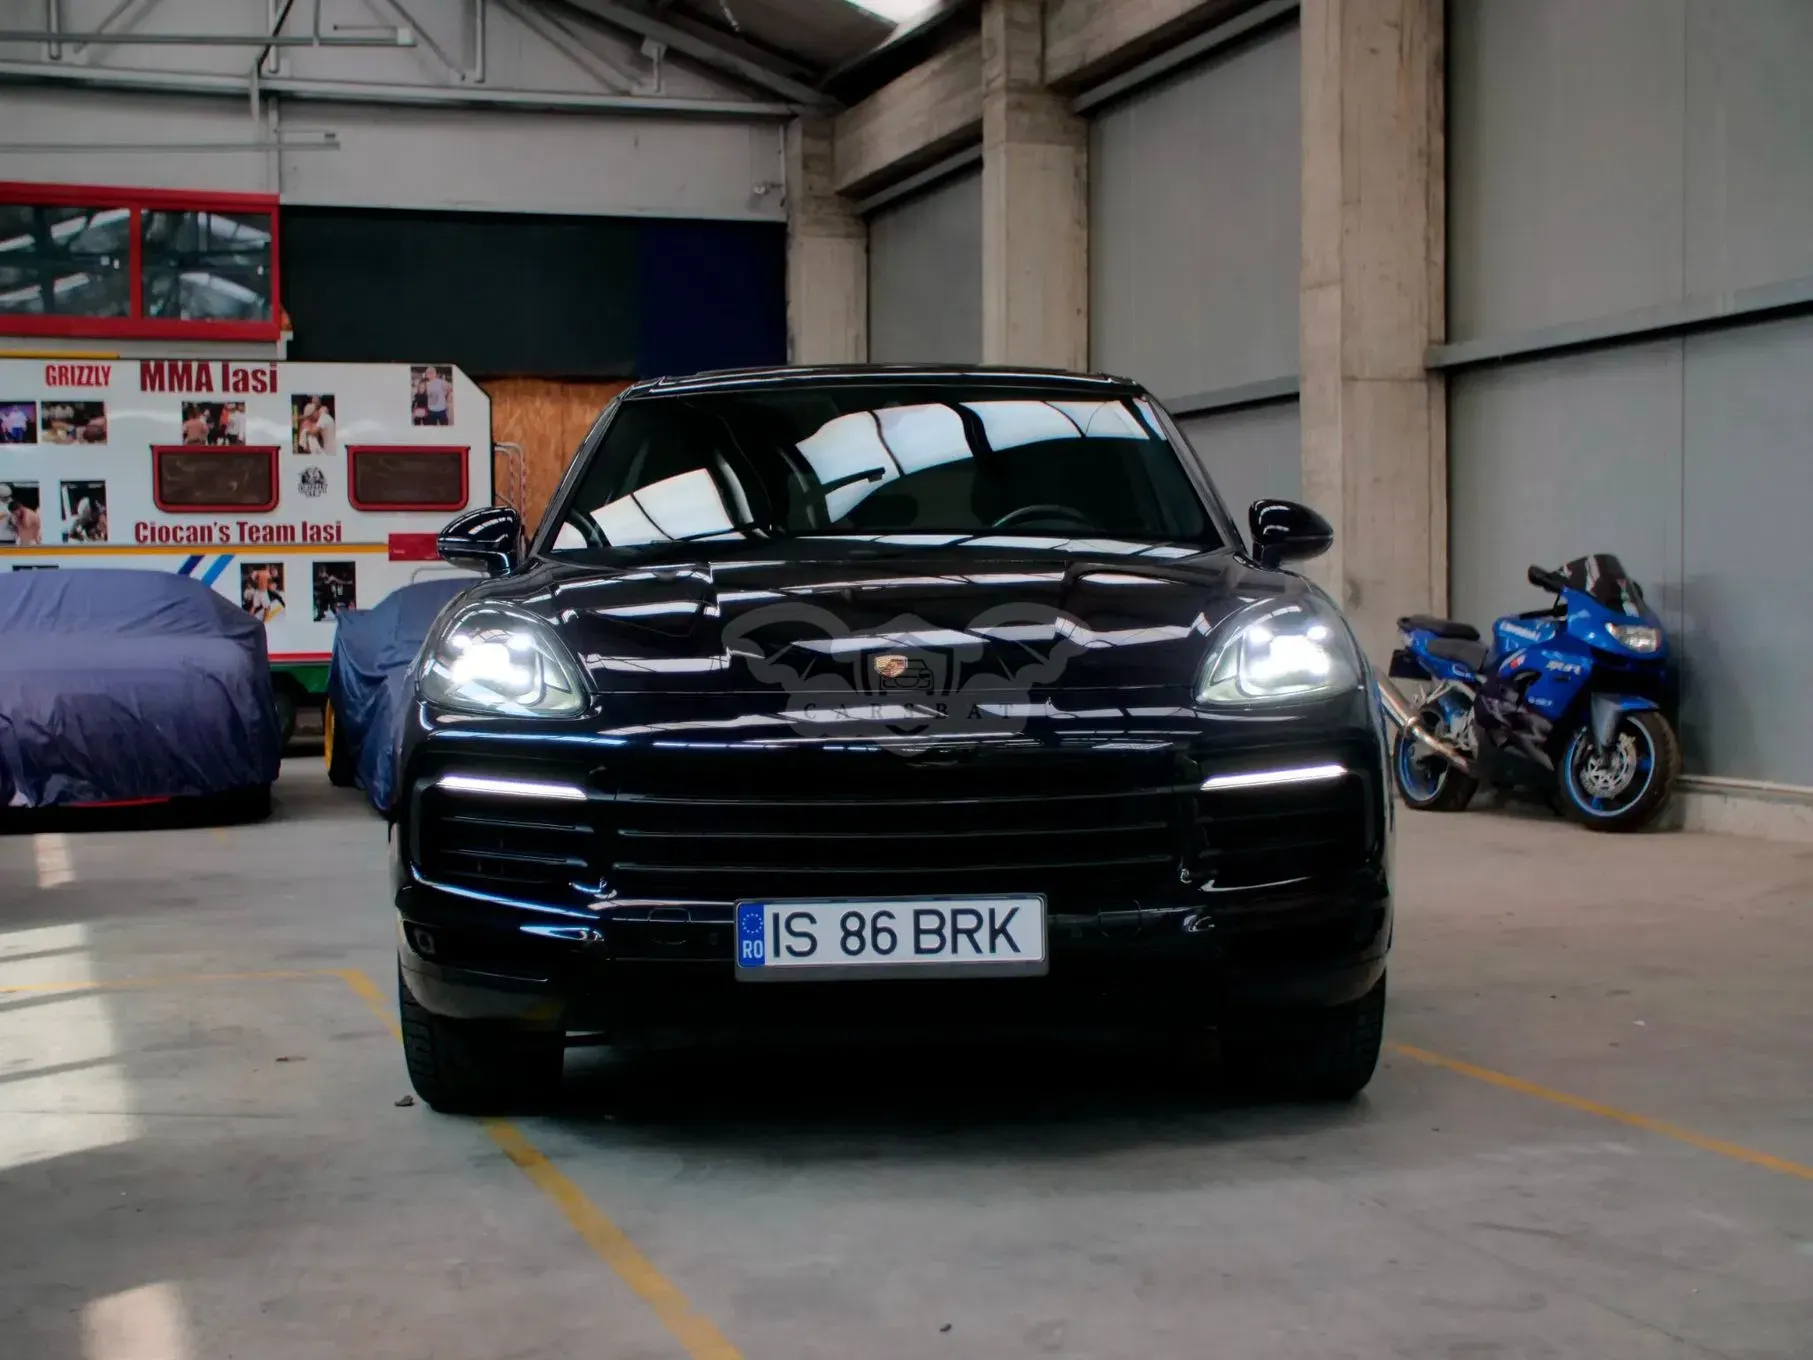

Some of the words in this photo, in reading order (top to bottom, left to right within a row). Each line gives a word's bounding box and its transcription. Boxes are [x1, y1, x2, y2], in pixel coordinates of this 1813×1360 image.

[45, 364, 112, 387] GRIZZLY
[140, 360, 214, 393] MMA
[221, 361, 278, 394] Iasi
[134, 521, 231, 545] Ciocan's
[236, 521, 297, 544] Team
[301, 520, 343, 544] Iasi
[772, 911, 818, 959] IS
[839, 909, 898, 957] 86
[912, 905, 1022, 955] BRK
[742, 939, 764, 959] RO
